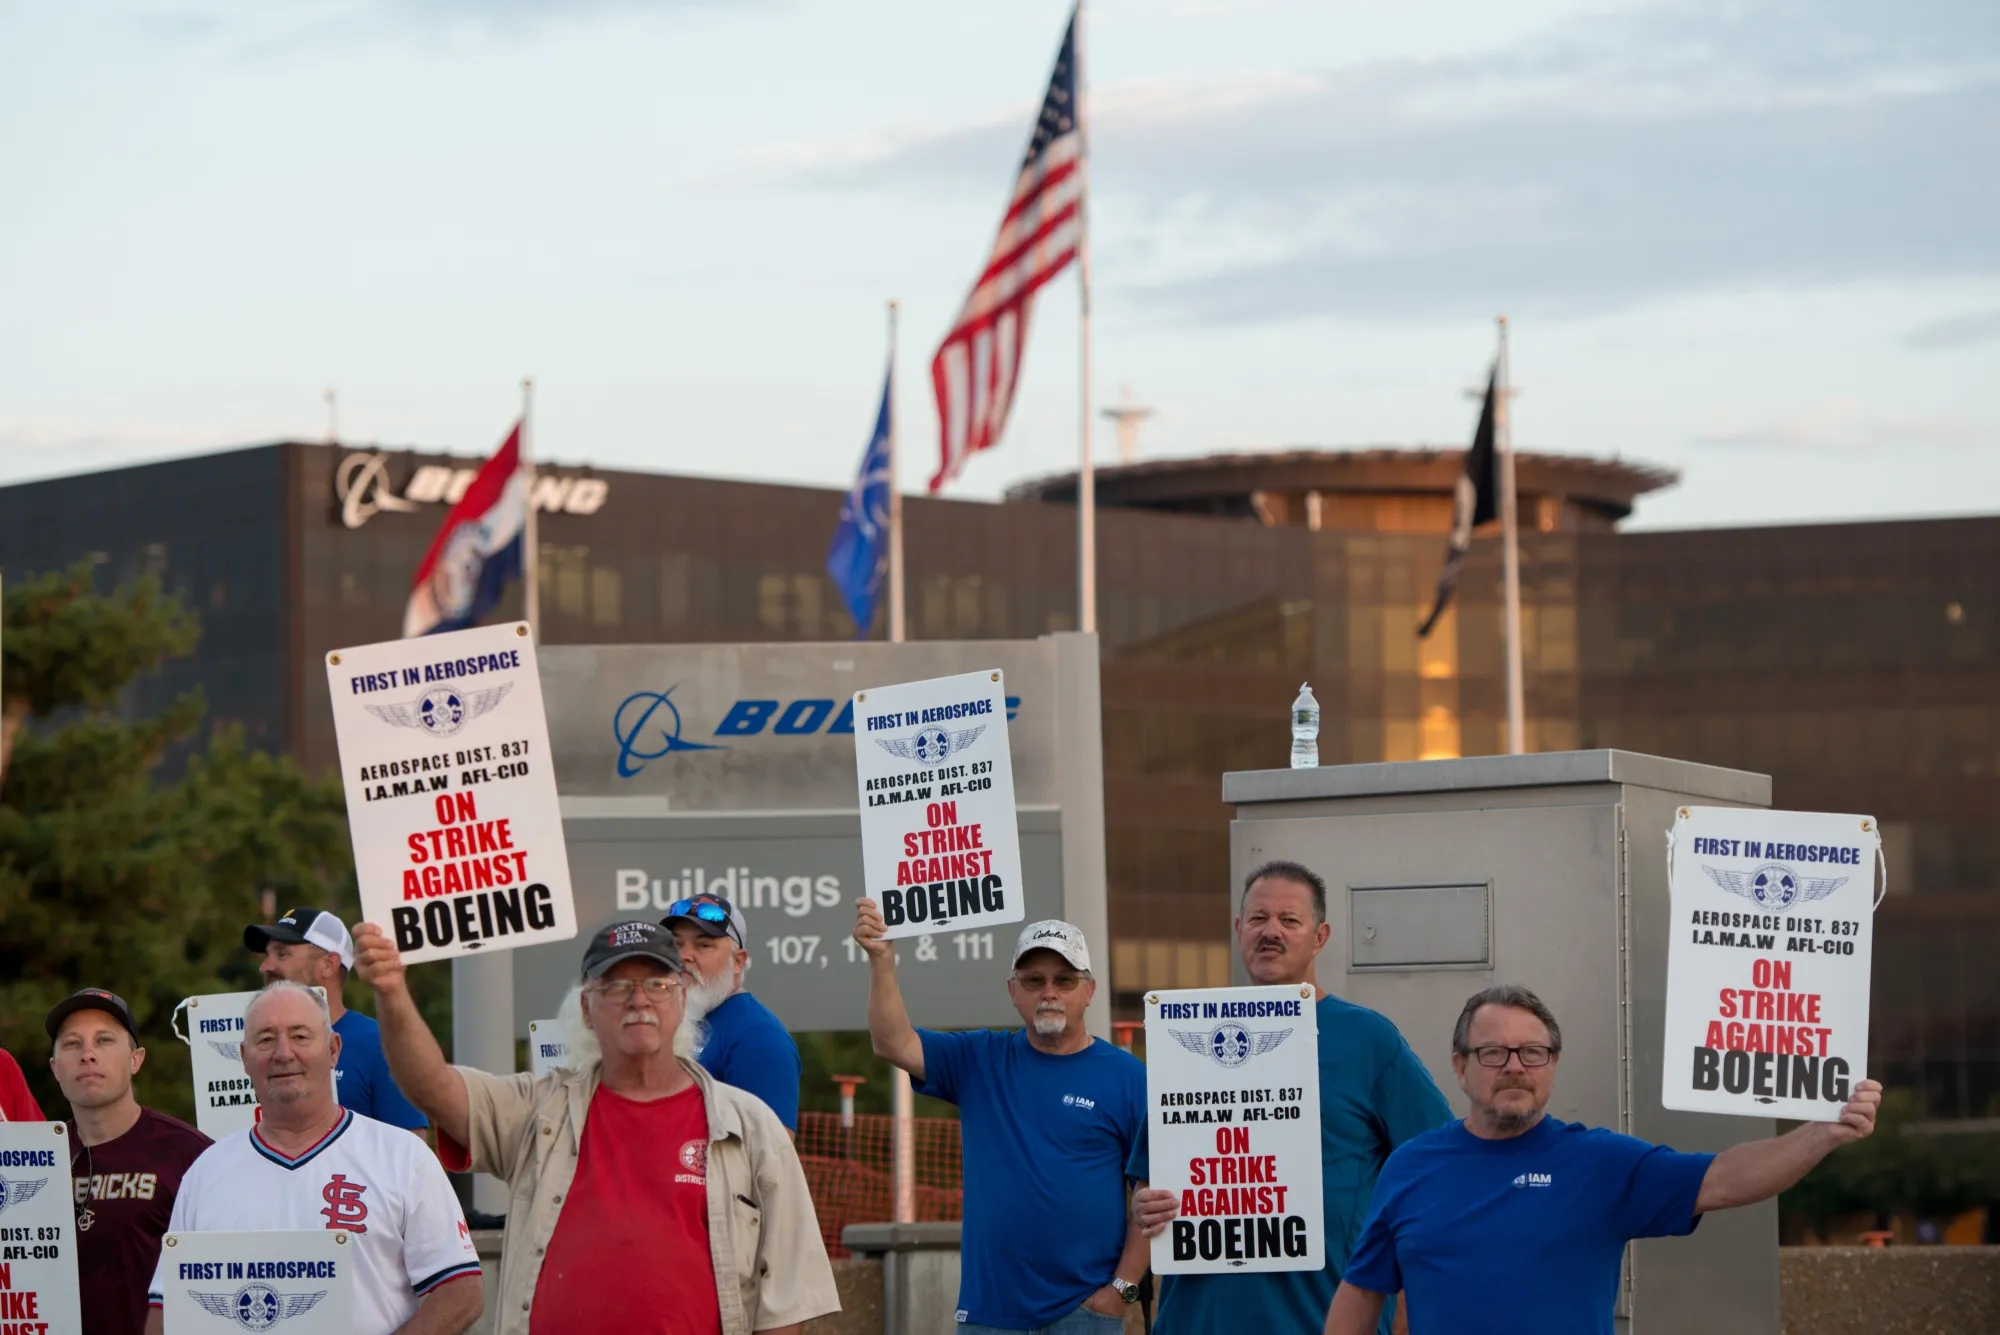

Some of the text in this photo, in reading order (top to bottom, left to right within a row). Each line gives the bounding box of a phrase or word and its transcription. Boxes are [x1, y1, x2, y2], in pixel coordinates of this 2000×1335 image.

[351, 650, 520, 694] FIRST IN AEROSPACE
[867, 713, 902, 731] FIRST
[906, 711, 919, 725] IN
[922, 699, 992, 723] AEROSPACE
[360, 740, 529, 782] AEROSPACE DIST. 837
[866, 761, 993, 791] AEROSPACE DIST. 837
[365, 761, 529, 801] I.A.M.A.W AFL-CIO
[869, 777, 991, 807] I.A.M.A.W AFL-CIO
[435, 791, 476, 825] ON
[927, 801, 957, 828] ON
[408, 819, 514, 864] STRIKE
[904, 824, 983, 857] STRIKE
[1694, 838, 1860, 864] FIRST IN AEROSPACE
[403, 851, 528, 901] AGAINST
[897, 850, 992, 886] AGAINST
[616, 867, 841, 917] Buildings
[882, 874, 1004, 926] BOEING
[391, 883, 556, 952] BOEING
[1692, 911, 1859, 935] AEROSPACE DIST. 837
[766, 936, 828, 969] 107,
[914, 934, 938, 962] &
[953, 932, 994, 961] 111
[1692, 931, 1854, 955] I.A.M.A.W AFL-CIO
[1753, 959, 1791, 989] ON
[1160, 1000, 1301, 1019] FIRST IN AEROSPACE
[1719, 988, 1820, 1023] STRIKE
[200, 1018, 232, 1033] FIRST
[1705, 1021, 1832, 1057] AGAINST
[1692, 1047, 1849, 1102] BOEING
[211, 1094, 259, 1107] I.A.M.A.
[1075, 1096, 1095, 1108] IAM
[1161, 1088, 1303, 1106] AEROSPACE DIST. 837
[1163, 1106, 1300, 1124] I.A.M.A.W AFL-CIO
[1216, 1127, 1249, 1154] ON
[0, 1151, 55, 1166] OSPACE
[1190, 1156, 1277, 1185] STRIKE
[72, 1173, 158, 1204] ERICKS
[1529, 1173, 1551, 1183] IAM
[1181, 1186, 1287, 1216] AGAINST
[1, 1228, 60, 1241] DIST. 837
[1172, 1216, 1307, 1261] BOEING
[3, 1245, 58, 1259] AFL-CIO
[179, 1261, 335, 1279] FIRST IN AEROSPACE
